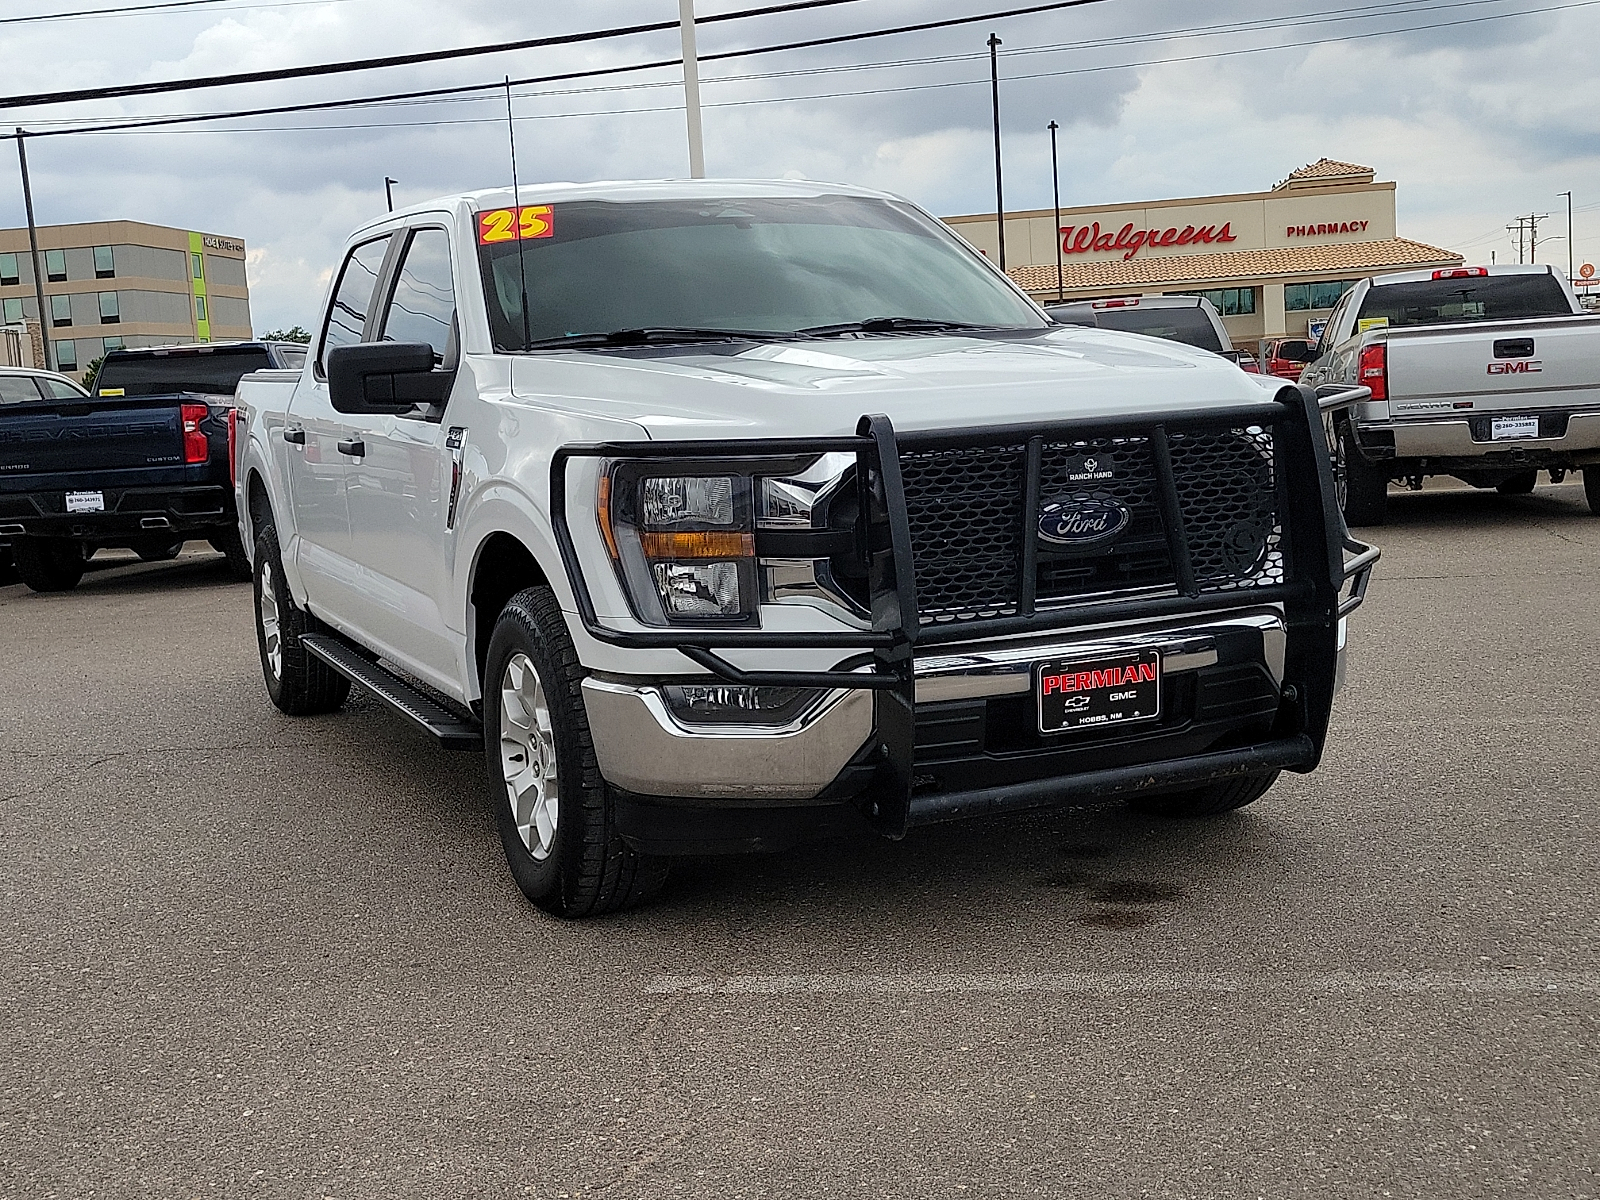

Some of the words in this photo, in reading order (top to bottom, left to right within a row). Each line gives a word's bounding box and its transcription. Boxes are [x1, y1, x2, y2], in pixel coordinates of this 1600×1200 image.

[481, 206, 552, 242] 25
[1286, 220, 1369, 238] PHARMACY
[1059, 221, 1237, 260] Walgreens
[1487, 360, 1543, 375] GMC
[1396, 401, 1451, 411] SIERRA
[146, 455, 181, 463] CUSTOM
[1093, 471, 1113, 479] HAND
[1056, 511, 1109, 535] Ford
[1043, 662, 1156, 695] PERMIAN
[1109, 690, 1137, 701] GMC
[1064, 705, 1090, 714] CHEVROLET
[1079, 714, 1109, 724] HOBBS,
[1110, 712, 1123, 720] NM
